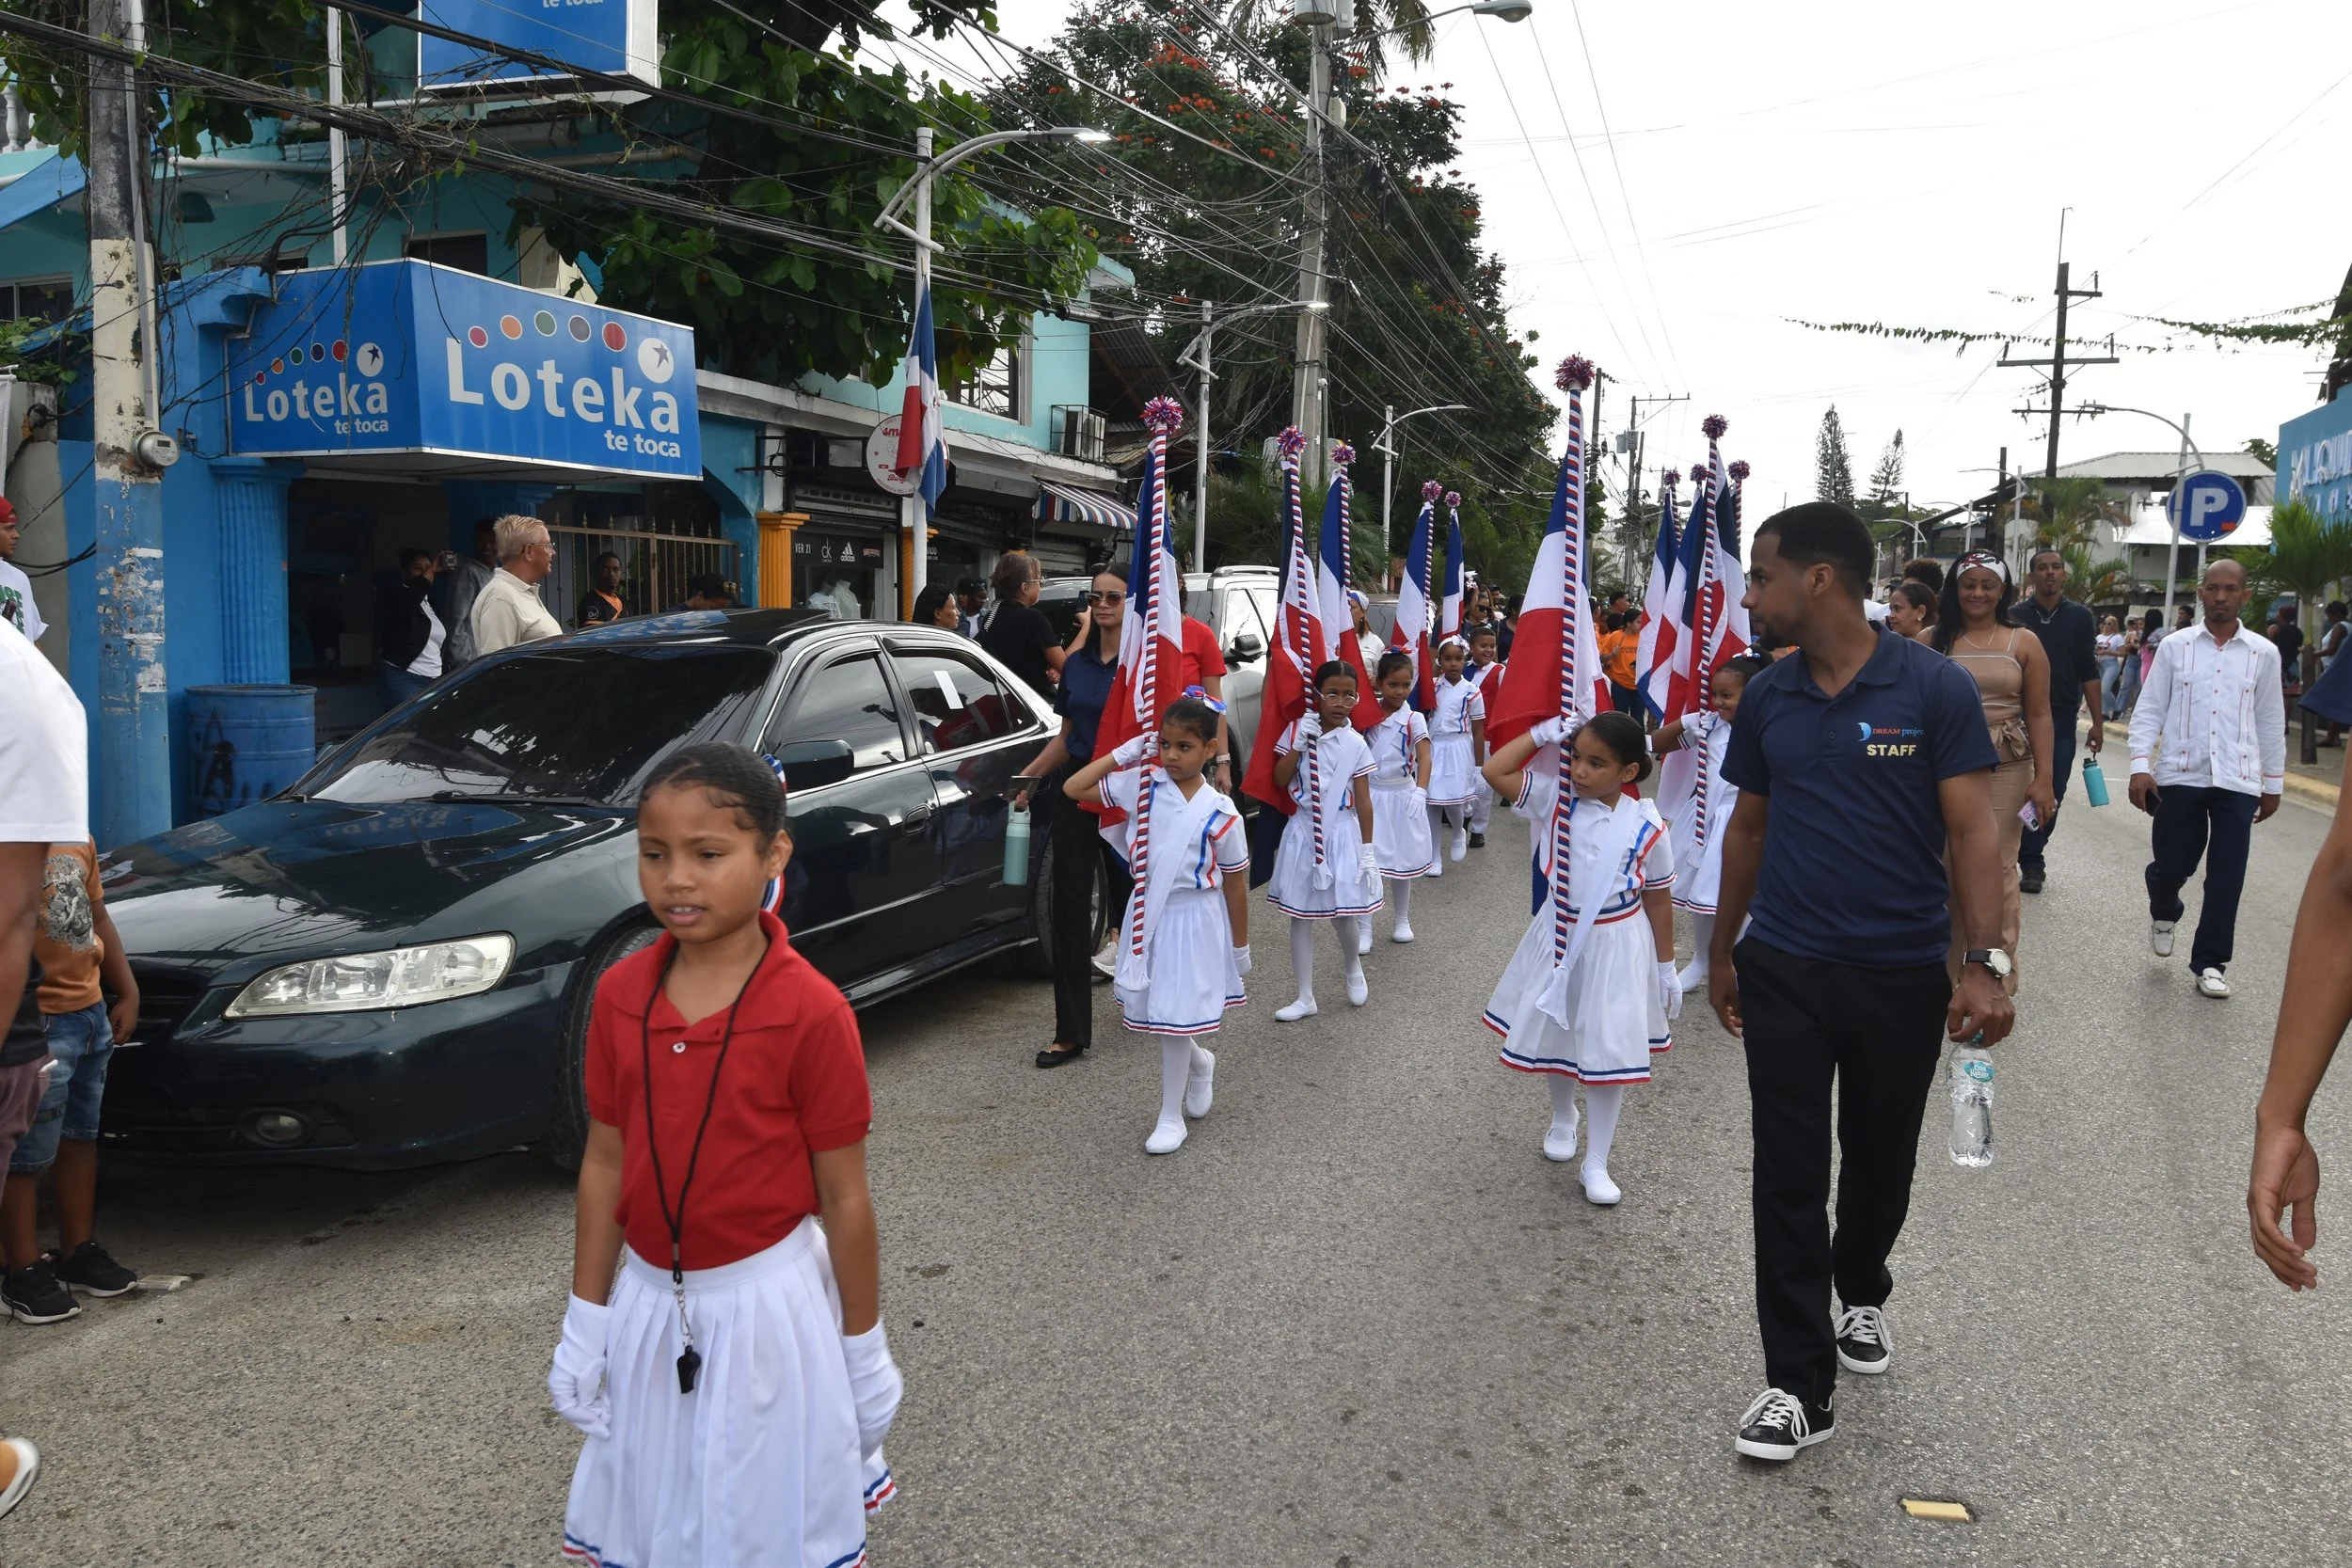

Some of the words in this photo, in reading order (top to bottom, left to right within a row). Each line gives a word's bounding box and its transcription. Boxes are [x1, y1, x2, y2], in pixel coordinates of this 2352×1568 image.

[245, 372, 388, 421] Loteka
[446, 337, 679, 435] Loteka
[334, 419, 350, 435] te
[355, 418, 389, 434] toca
[604, 429, 628, 451] te
[633, 434, 681, 458] toca
[2189, 487, 2229, 527] P
[1867, 744, 1916, 756] STAFF
